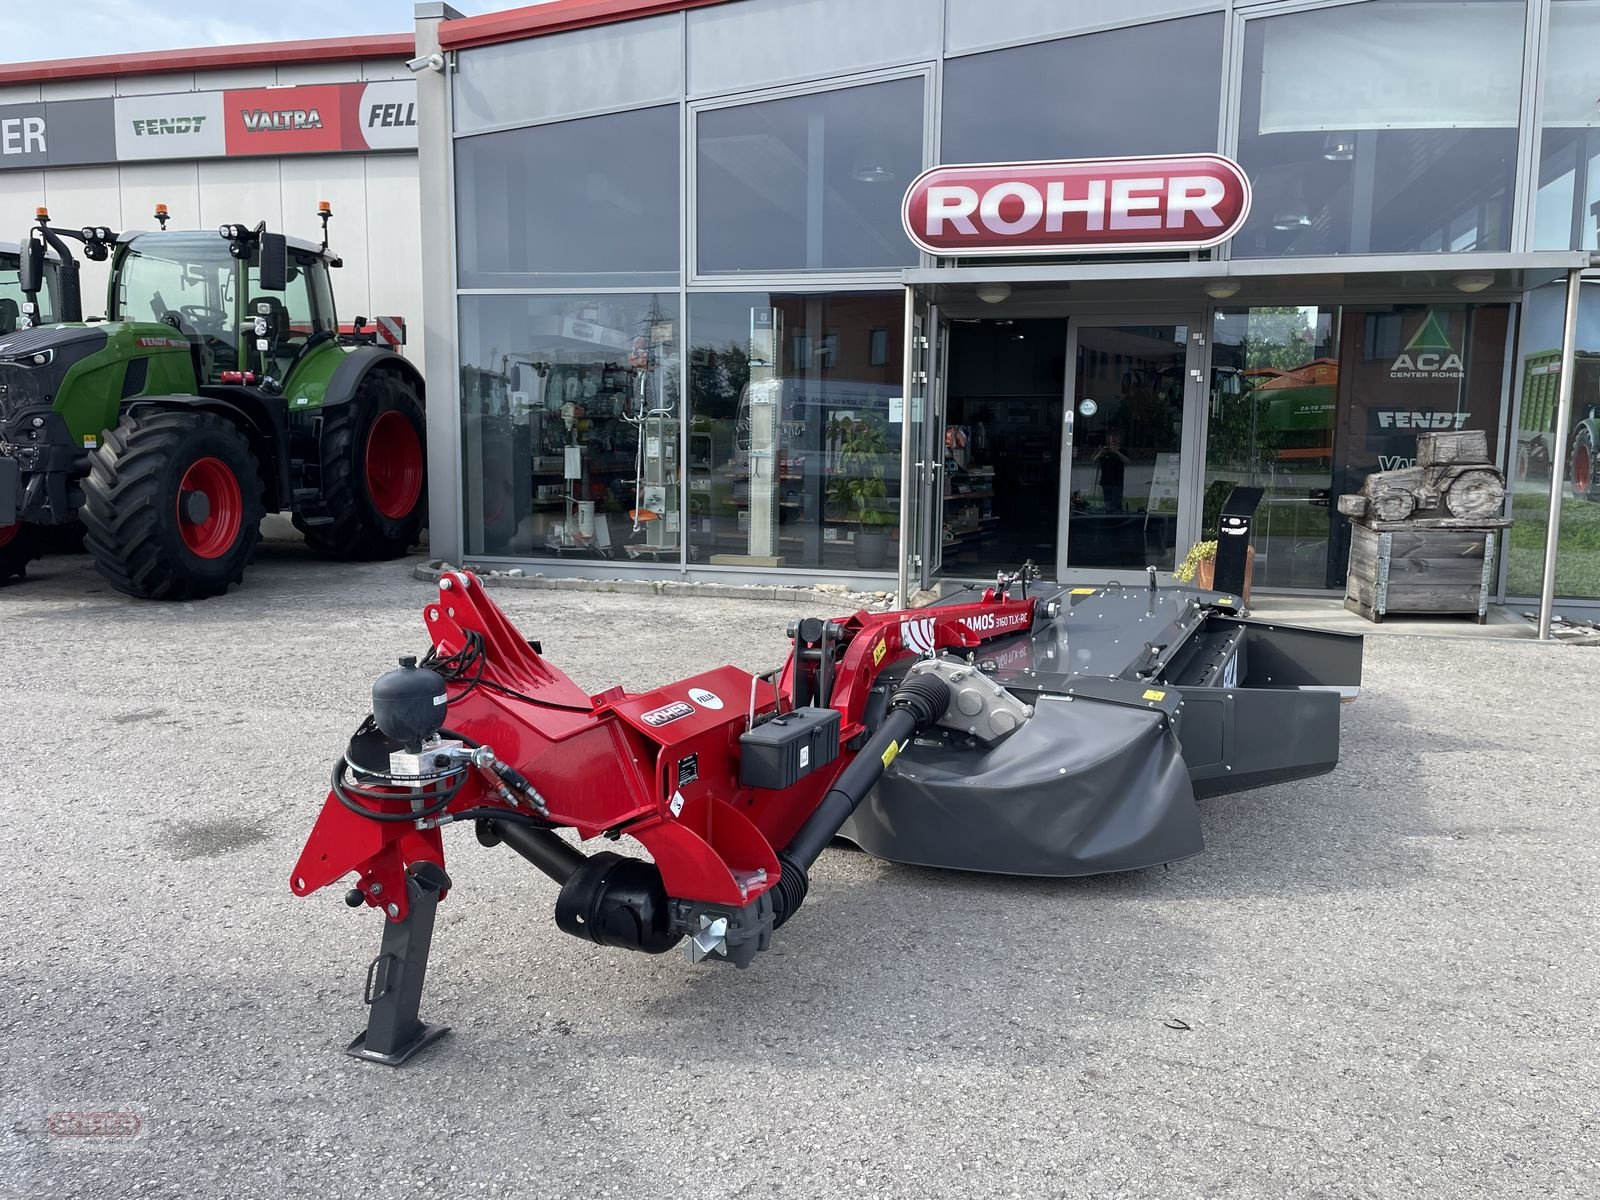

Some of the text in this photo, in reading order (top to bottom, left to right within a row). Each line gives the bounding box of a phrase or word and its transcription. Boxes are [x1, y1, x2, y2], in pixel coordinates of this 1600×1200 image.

[132, 116, 207, 136] FENDT
[241, 109, 323, 132] VALTRA
[368, 103, 418, 128] FELL
[1, 117, 47, 155] ER
[925, 175, 1226, 236] ROHER
[1390, 353, 1465, 371] ACA
[1377, 411, 1472, 429] FENDT
[696, 693, 716, 704] FELLA
[643, 702, 693, 725] ROHER
